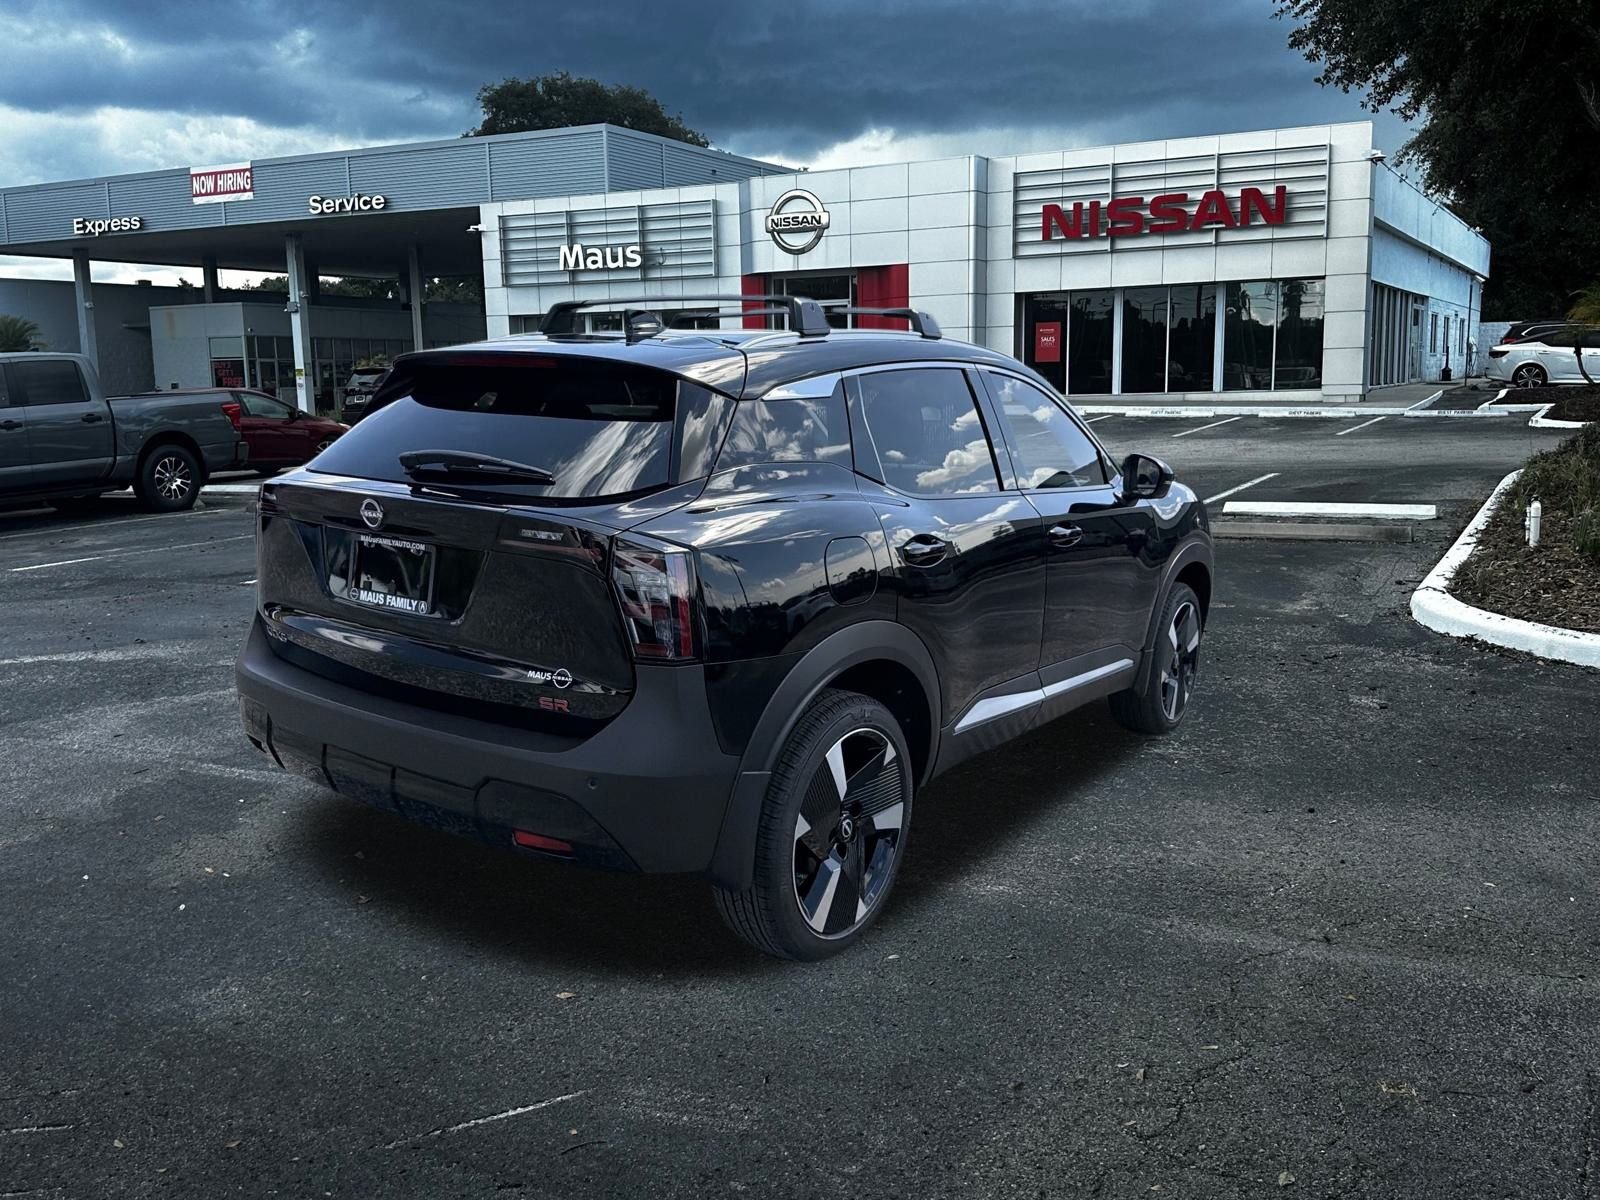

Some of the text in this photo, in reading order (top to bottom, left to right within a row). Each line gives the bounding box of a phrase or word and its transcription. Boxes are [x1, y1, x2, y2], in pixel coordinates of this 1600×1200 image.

[193, 171, 250, 195] NOW HIRING
[309, 193, 385, 215] Service
[1042, 185, 1287, 241] NISSAN
[73, 216, 141, 236] Express
[770, 214, 822, 229] NISSAN
[559, 243, 642, 272] Maus
[360, 535, 426, 550] MAUSFAMILYAUTO.COM
[360, 590, 417, 611] MAUS FAMILY
[527, 670, 552, 681] MAUS
[539, 696, 570, 712] SR
